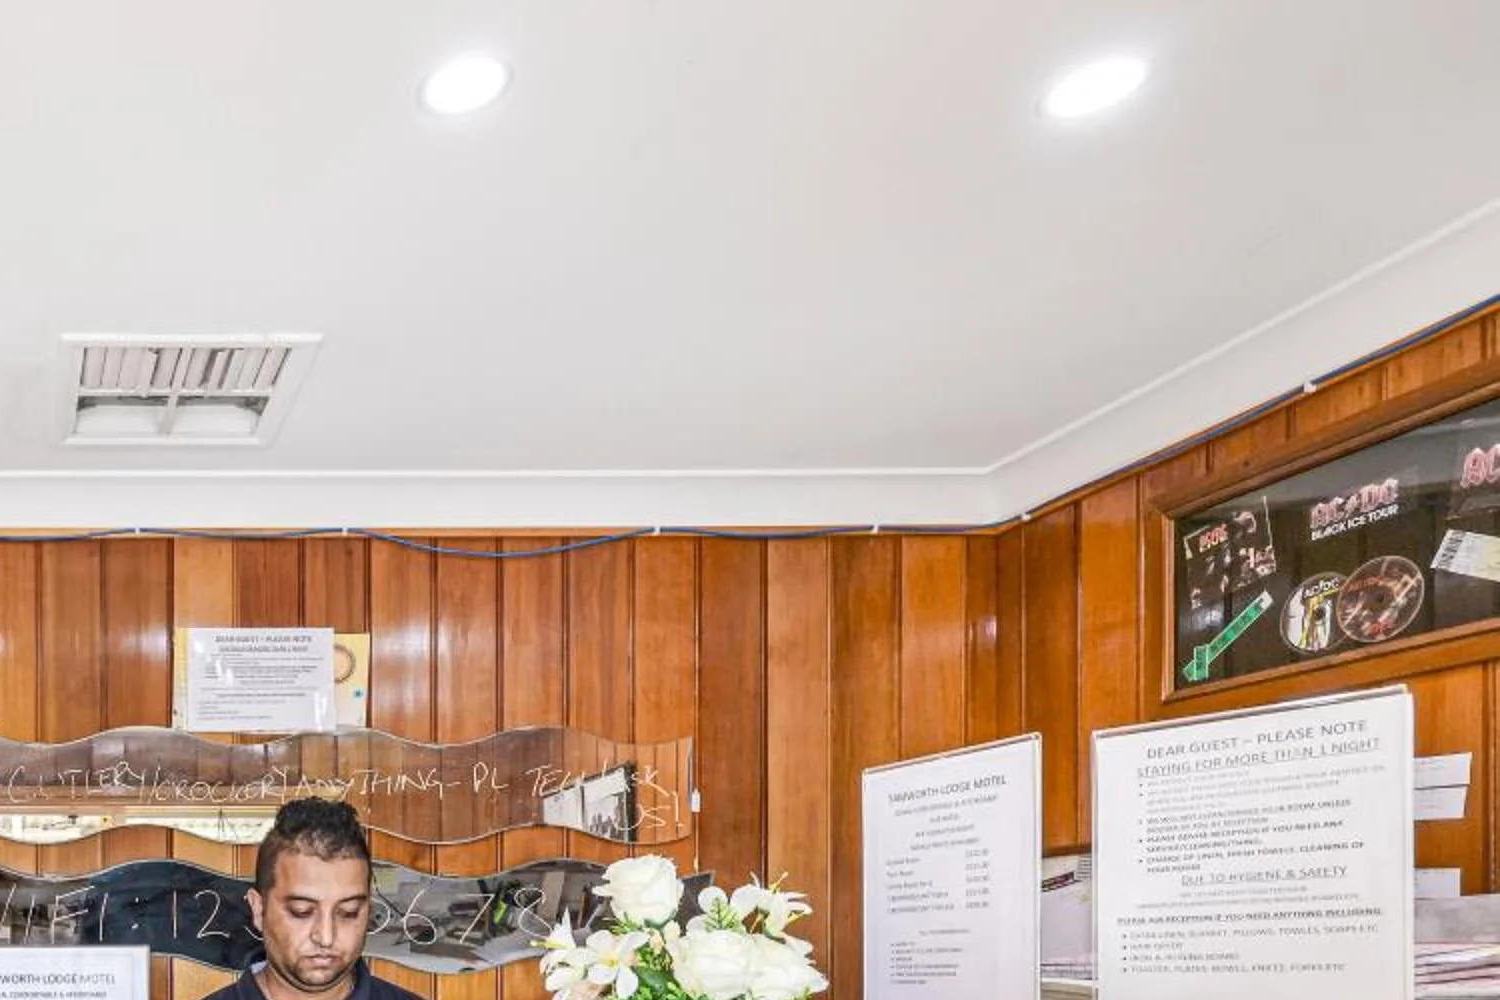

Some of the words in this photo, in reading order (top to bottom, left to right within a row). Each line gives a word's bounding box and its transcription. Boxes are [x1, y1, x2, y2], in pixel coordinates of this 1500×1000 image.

[1348, 515, 1367, 528] ICE
[1368, 504, 1399, 522] TOUR
[1147, 744, 1185, 760] DEAR
[1189, 737, 1238, 754] GUEST
[1257, 727, 1315, 745] PLEASE
[1321, 720, 1368, 736] NOTE
[1137, 761, 1190, 778] STAYING
[1196, 757, 1221, 772] FOR
[1225, 752, 1268, 768] MORE
[1331, 738, 1380, 753] NIGHT
[973, 775, 1007, 789] MOTEL
[1299, 864, 1348, 878] SAFETY
[42, 973, 77, 985] LODGE
